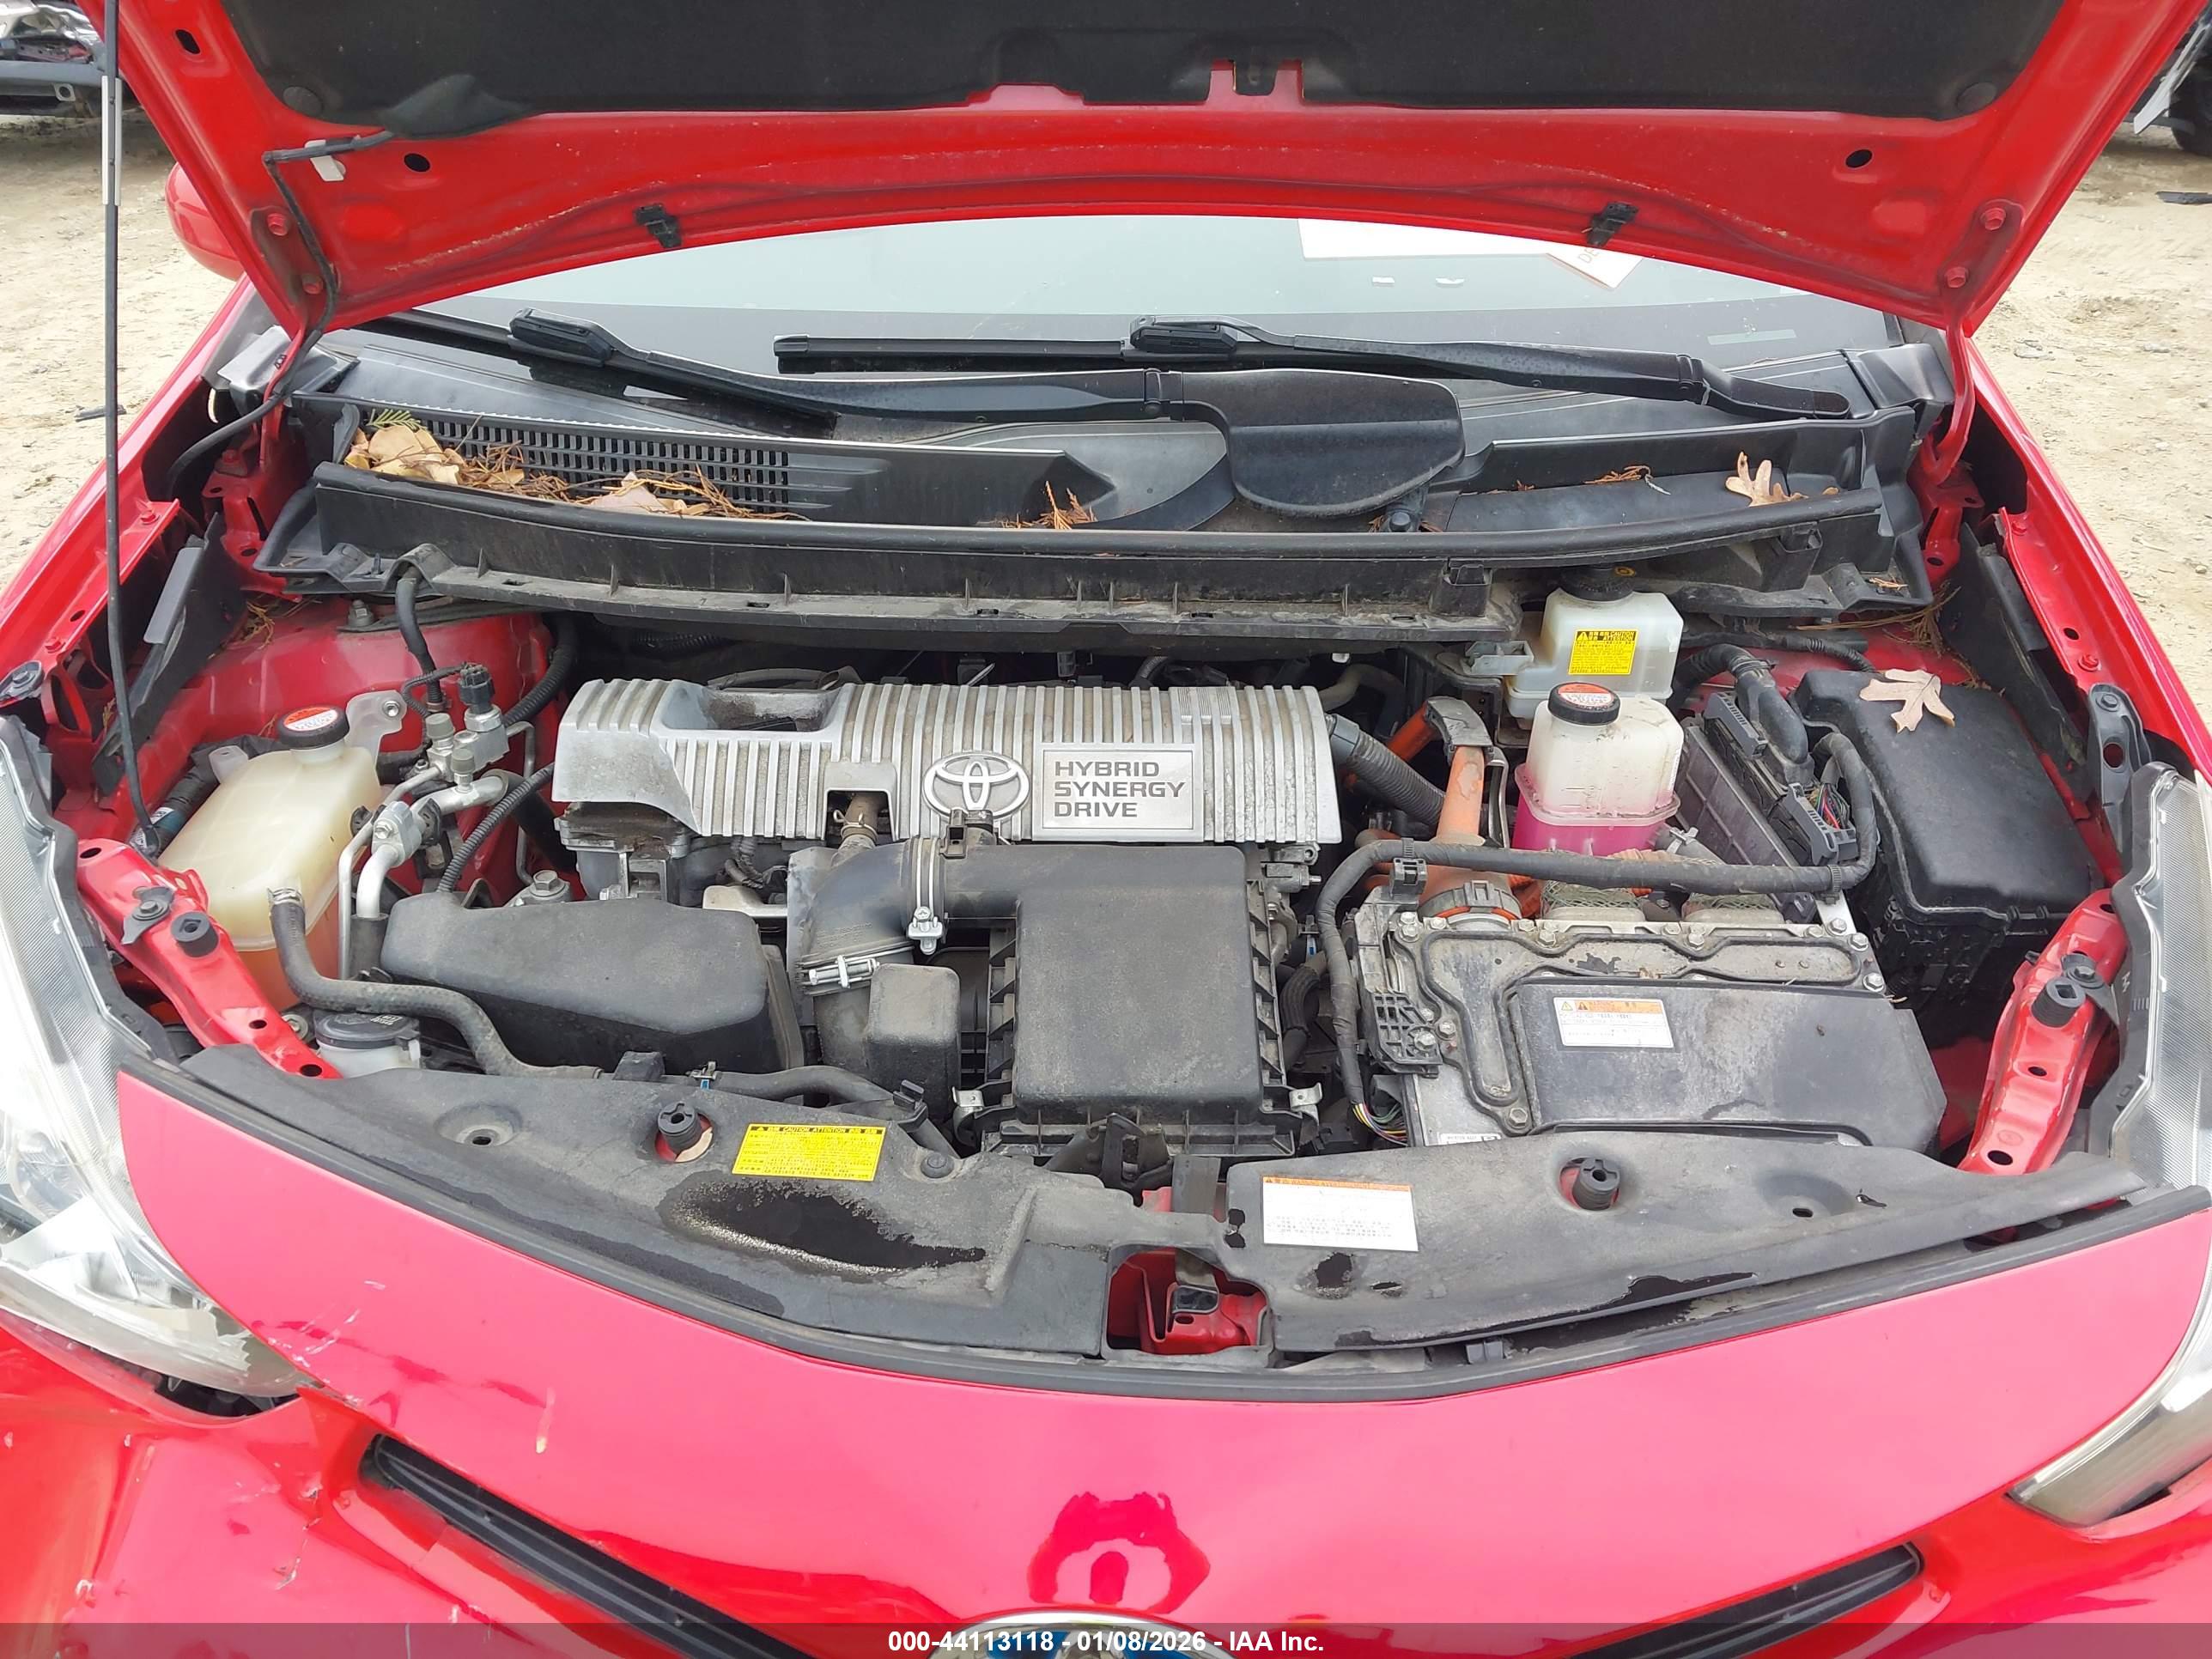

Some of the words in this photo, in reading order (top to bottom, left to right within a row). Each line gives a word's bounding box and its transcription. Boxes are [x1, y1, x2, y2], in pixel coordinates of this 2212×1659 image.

[1054, 761, 1159, 777] HYBRID
[1054, 781, 1185, 798] SYNERGY
[1054, 801, 1138, 817] DRIVE
